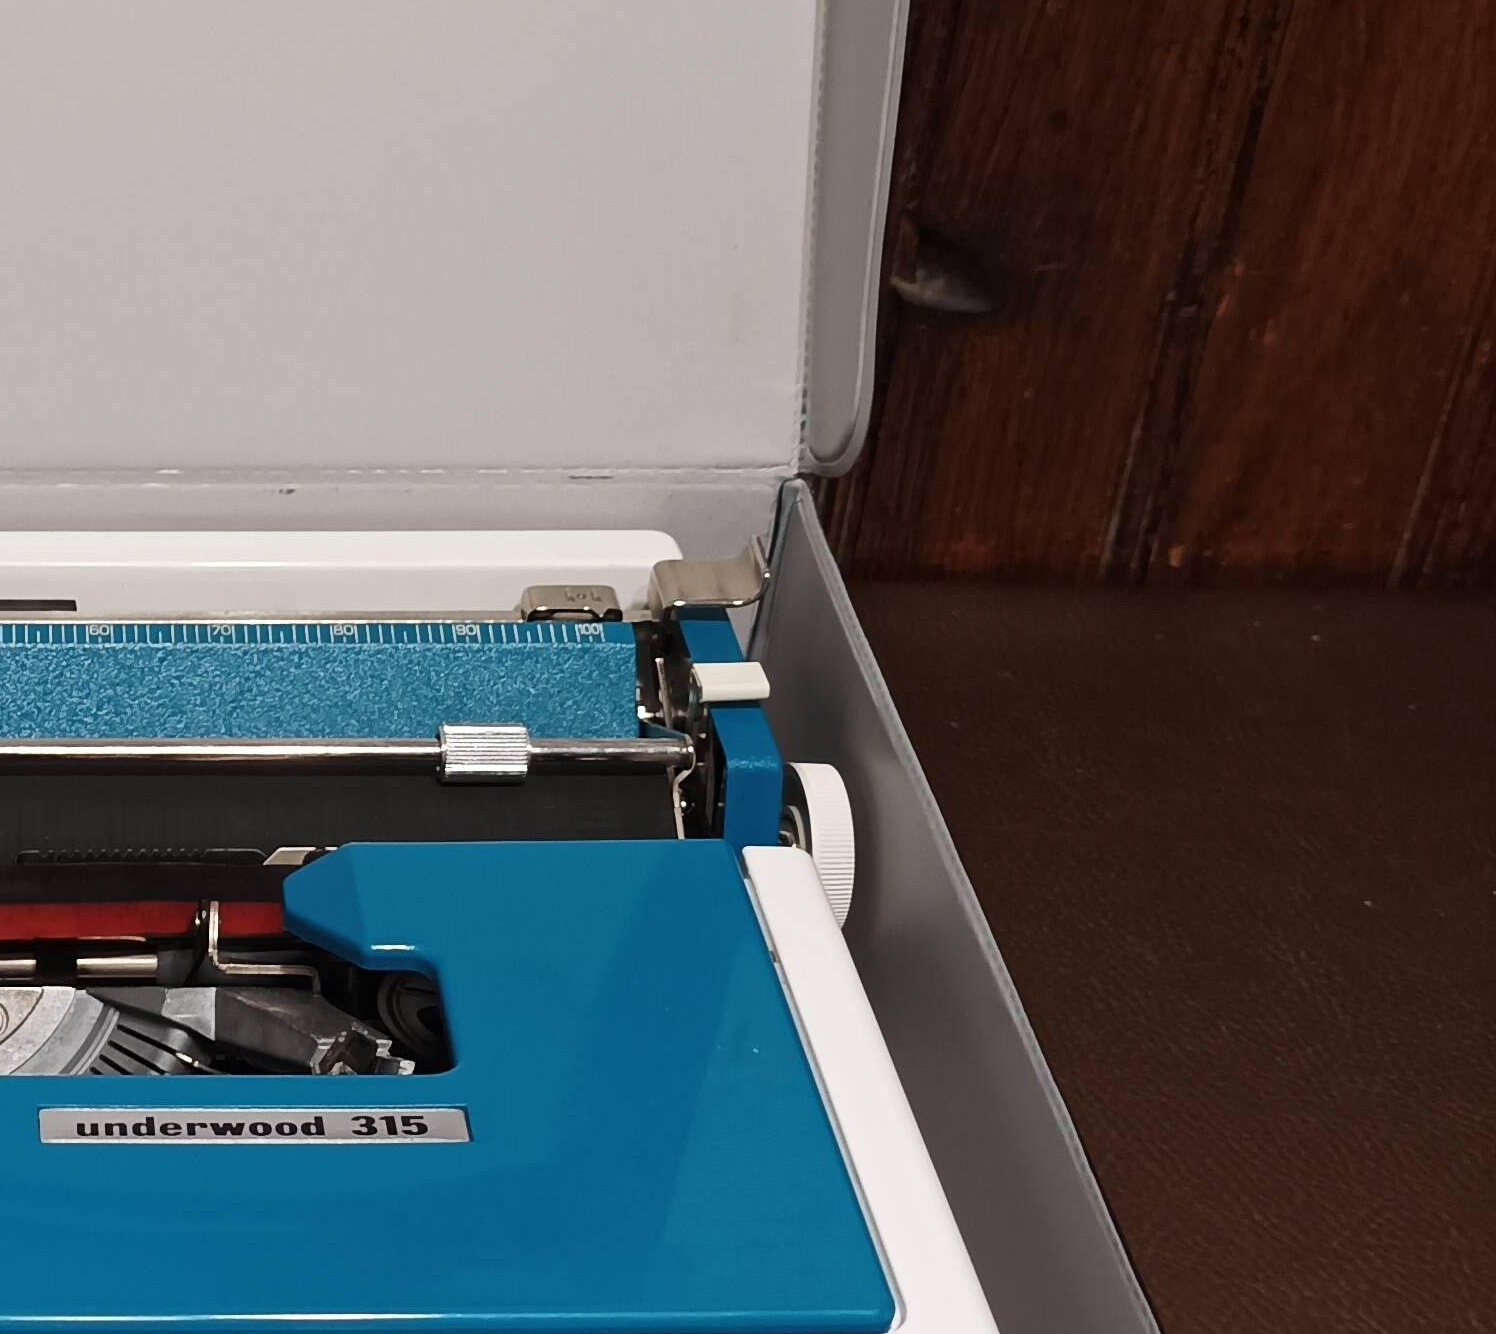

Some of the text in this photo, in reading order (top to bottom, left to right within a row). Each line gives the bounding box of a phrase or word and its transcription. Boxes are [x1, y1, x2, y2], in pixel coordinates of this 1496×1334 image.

[89, 623, 110, 636] 60
[211, 623, 231, 636] 70
[333, 623, 354, 636] 80
[455, 623, 477, 636] 90
[577, 623, 601, 636] 100
[76, 1115, 429, 1137] underwood 315
